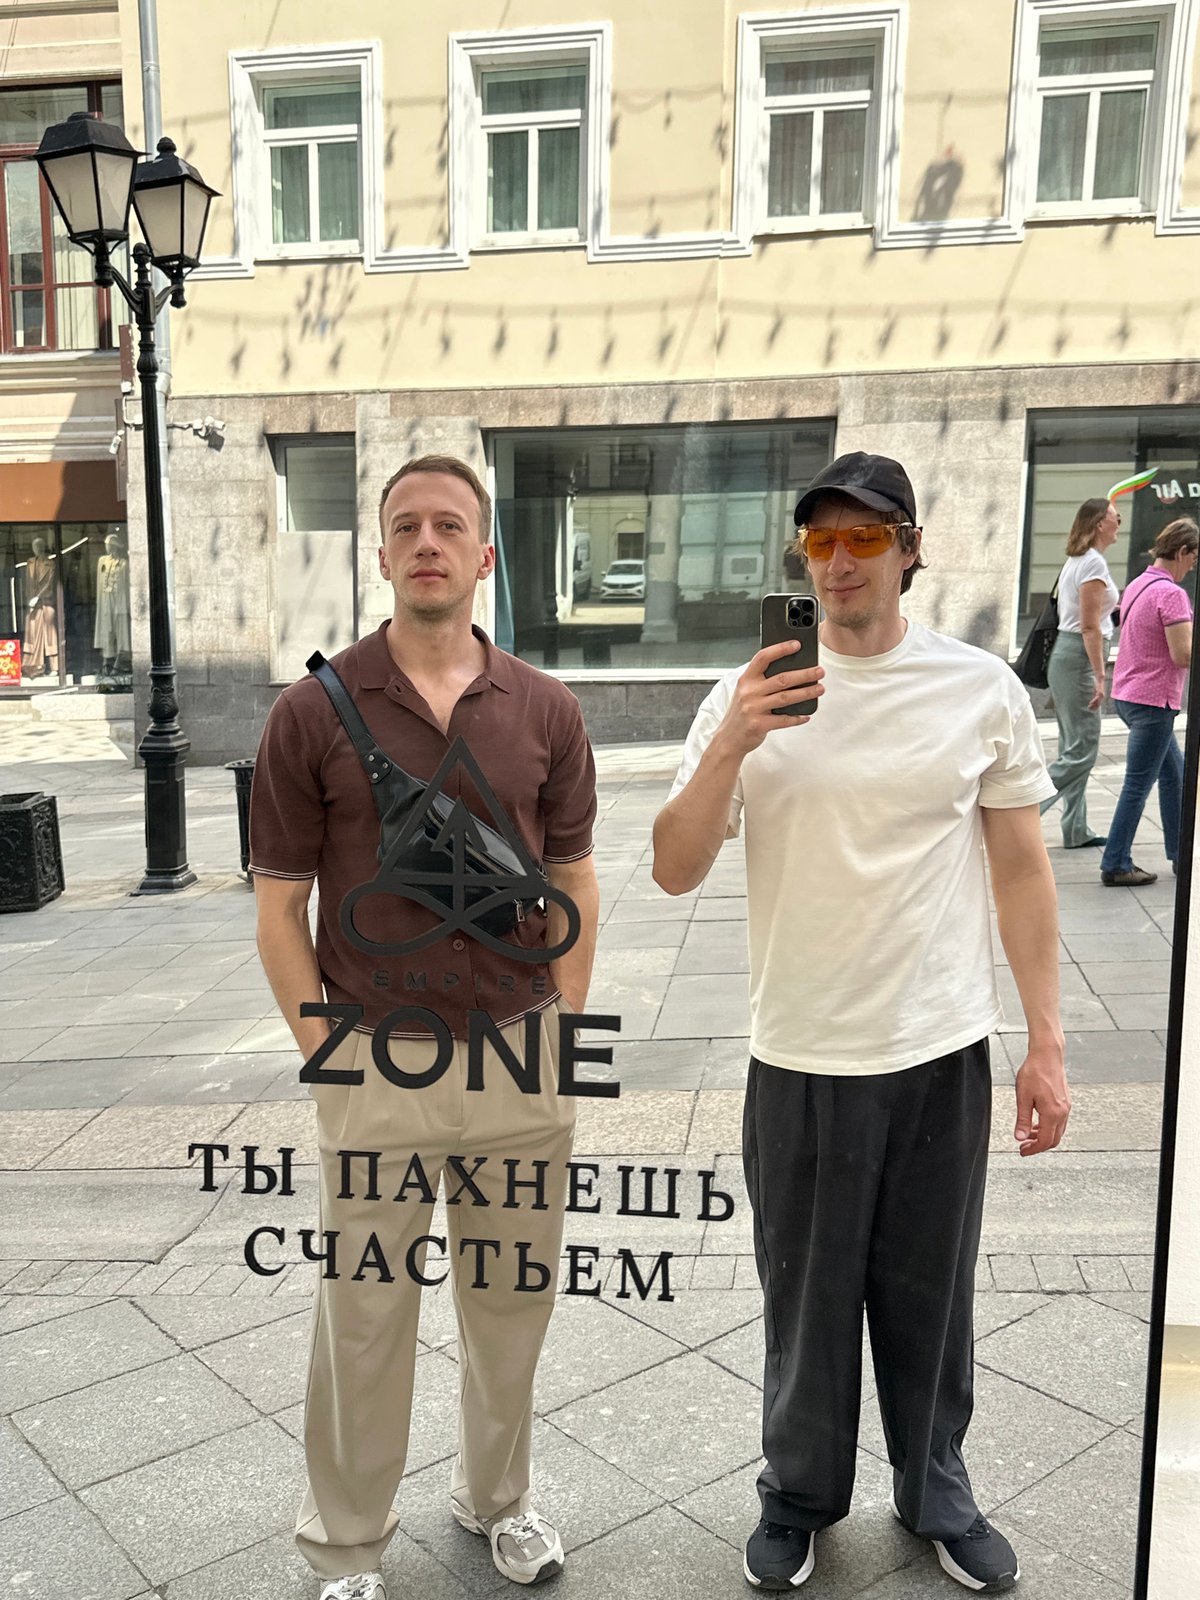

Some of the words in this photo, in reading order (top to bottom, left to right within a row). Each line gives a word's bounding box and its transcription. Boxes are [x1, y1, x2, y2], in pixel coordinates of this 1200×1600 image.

[373, 969, 548, 996] EMPIRE
[300, 1002, 621, 1098] ZONE
[188, 1143, 296, 1196] ТЫ
[337, 1150, 735, 1222] ПАХНЕШЬ
[244, 1226, 674, 1302] СЧАСТЬЕМ
